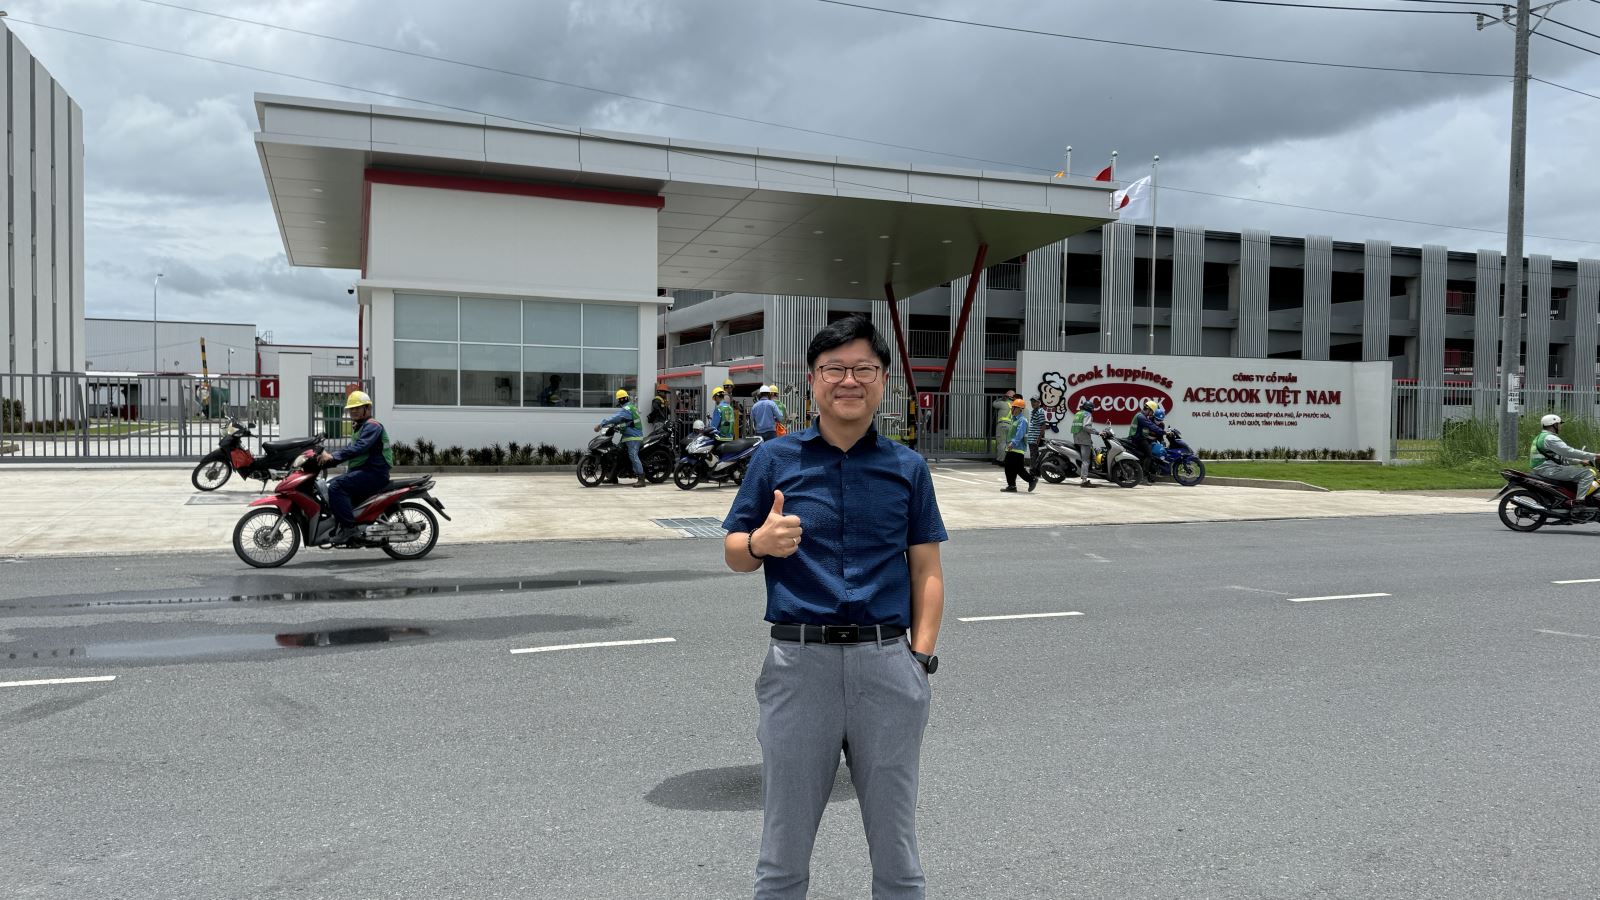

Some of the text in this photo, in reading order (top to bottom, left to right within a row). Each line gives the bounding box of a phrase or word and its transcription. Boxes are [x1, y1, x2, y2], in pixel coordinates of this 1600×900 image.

[1068, 364, 1173, 389] Cook happiness
[1232, 372, 1254, 382] CÔNG
[1266, 371, 1277, 382] CỔ
[1278, 372, 1298, 383] PHẦN
[266, 381, 274, 396] 1
[1182, 385, 1342, 407] ACECOOK VIỆT NAM
[923, 395, 930, 406] 1
